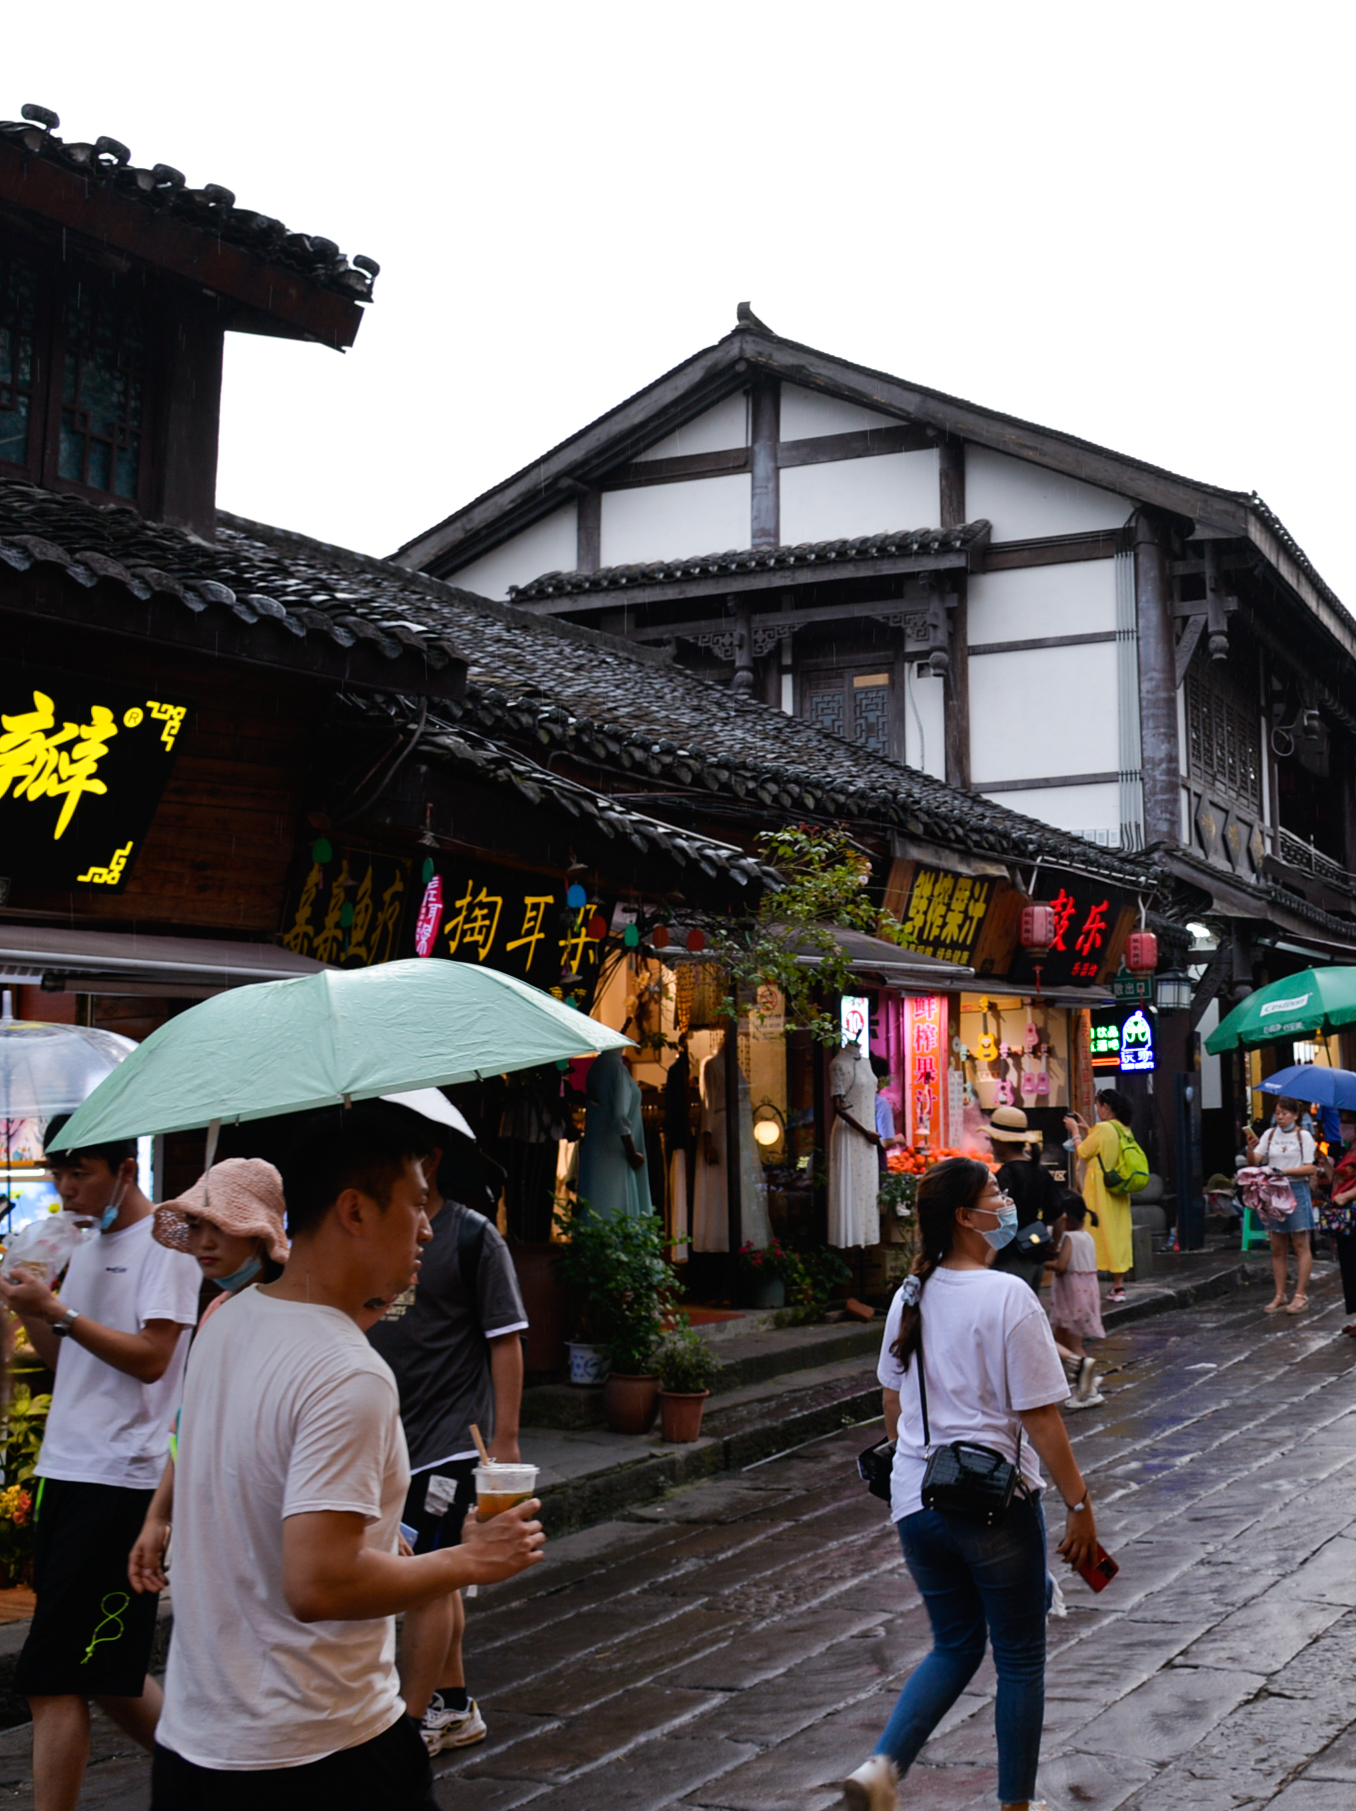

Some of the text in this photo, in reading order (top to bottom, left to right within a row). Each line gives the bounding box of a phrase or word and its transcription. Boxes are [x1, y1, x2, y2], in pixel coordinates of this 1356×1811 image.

[444, 879, 600, 975] 掏耳朵
[904, 870, 988, 945] 鲜榨果汁
[914, 995, 938, 1117] 鲜榨果汁
[1090, 1025, 1119, 1039] 饮品
[1090, 1039, 1120, 1052] 酒吧
